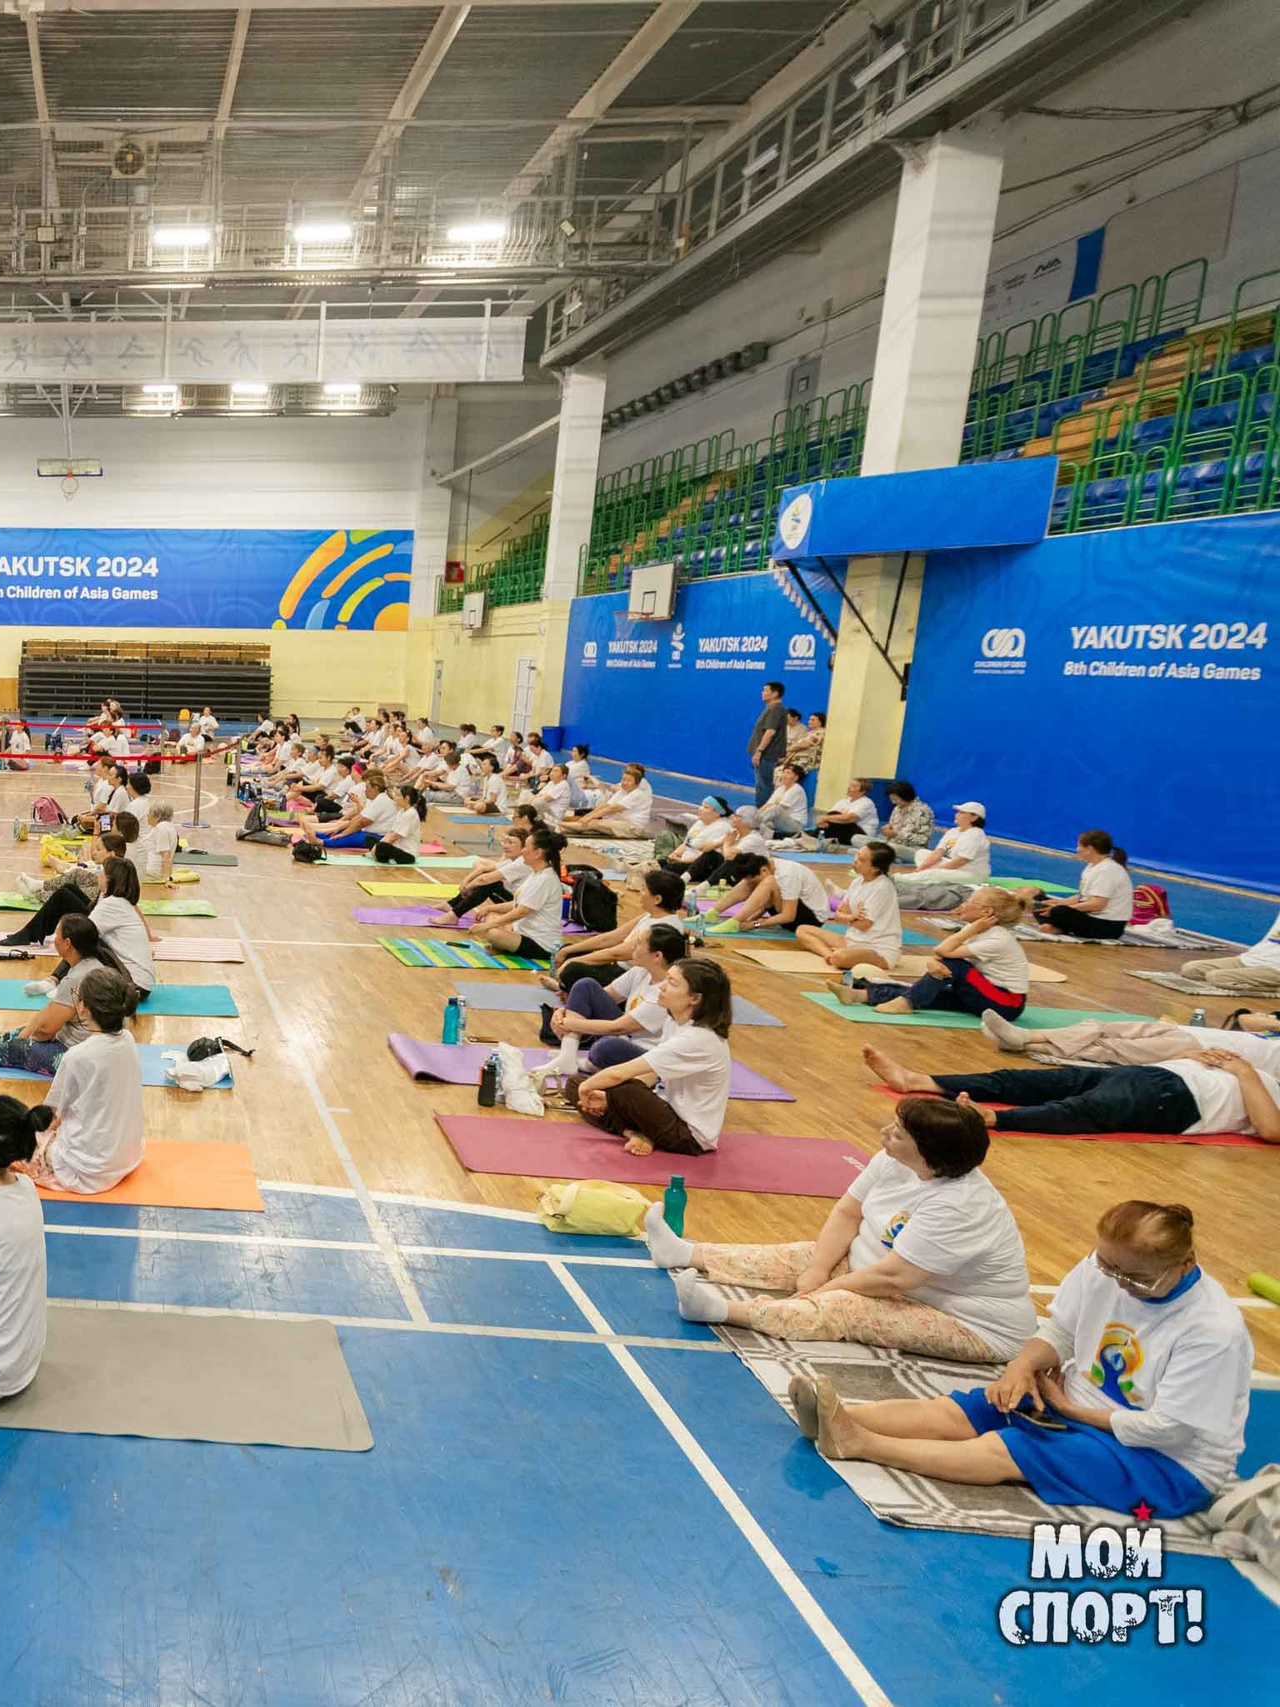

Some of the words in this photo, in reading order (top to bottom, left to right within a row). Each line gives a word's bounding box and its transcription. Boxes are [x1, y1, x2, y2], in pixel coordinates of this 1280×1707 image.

[96, 557, 159, 577] 2024
[6, 586, 61, 599] Children
[64, 586, 78, 599] of
[80, 587, 109, 599] Asia
[111, 587, 158, 600] Games
[699, 636, 740, 653] YAKUTSK
[741, 635, 768, 652] 2024
[1071, 624, 1187, 649] YAKUTSK
[1189, 622, 1267, 650] 2024
[608, 640, 638, 654] YAKUTSK
[639, 640, 658, 654] 2024
[1063, 661, 1087, 676] 8th
[1089, 661, 1146, 678] Children
[1148, 662, 1165, 678] of
[1165, 663, 1199, 679] Asia
[1203, 663, 1261, 680] Games
